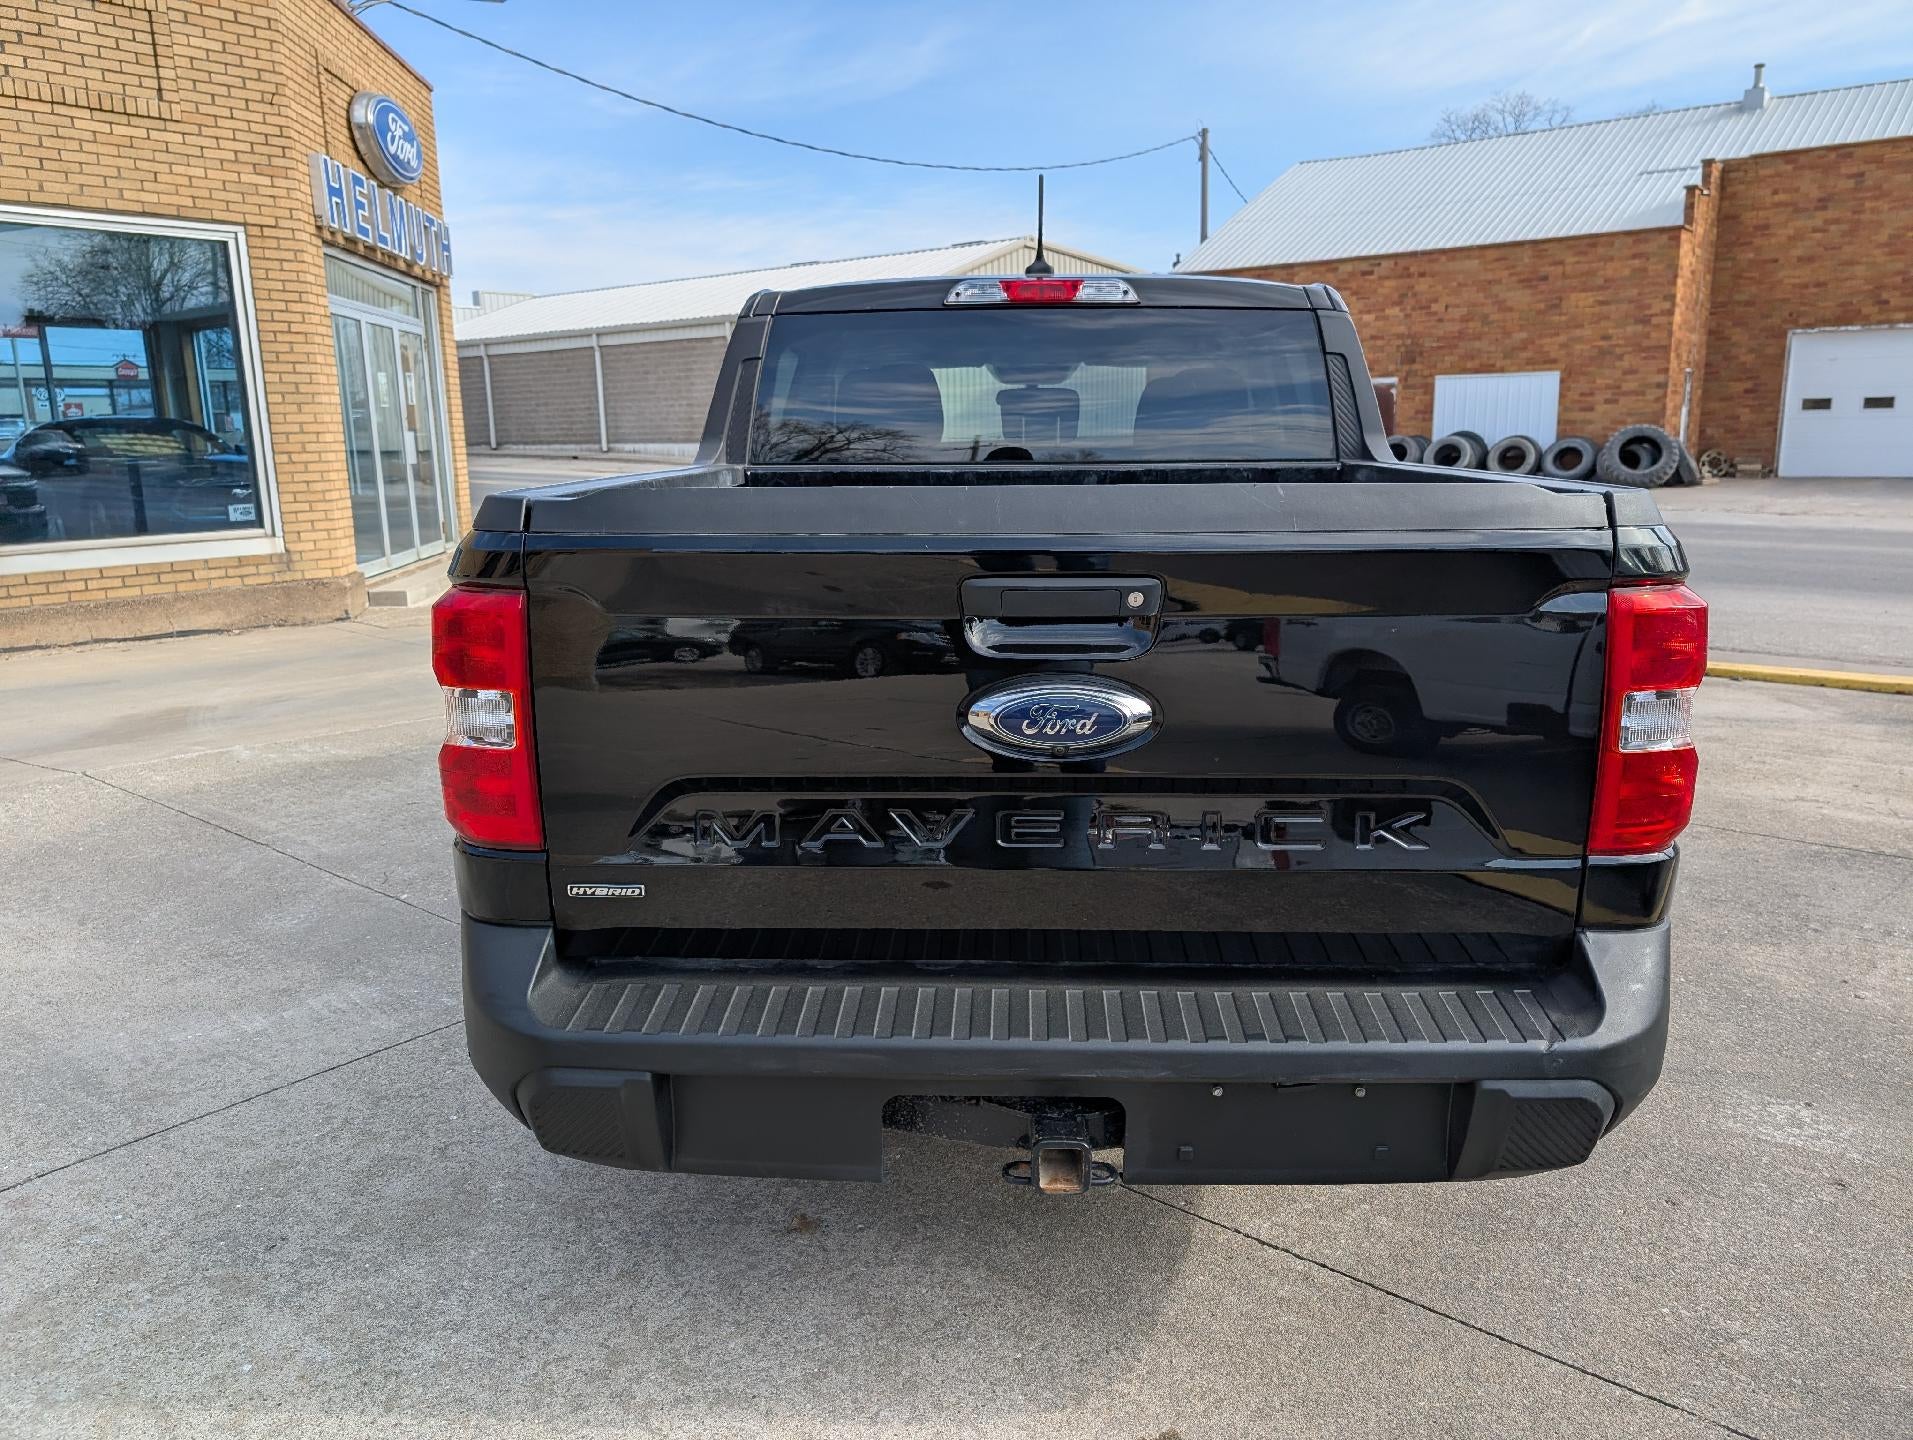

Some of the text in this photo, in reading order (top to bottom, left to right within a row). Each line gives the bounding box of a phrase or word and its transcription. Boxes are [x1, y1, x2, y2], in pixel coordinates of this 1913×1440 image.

[386, 112, 419, 170] Ford
[320, 153, 453, 277] HELMUTH
[1021, 702, 1099, 736] Ford
[695, 807, 1431, 850] MAVERICK
[570, 886, 642, 897] HYBRID
